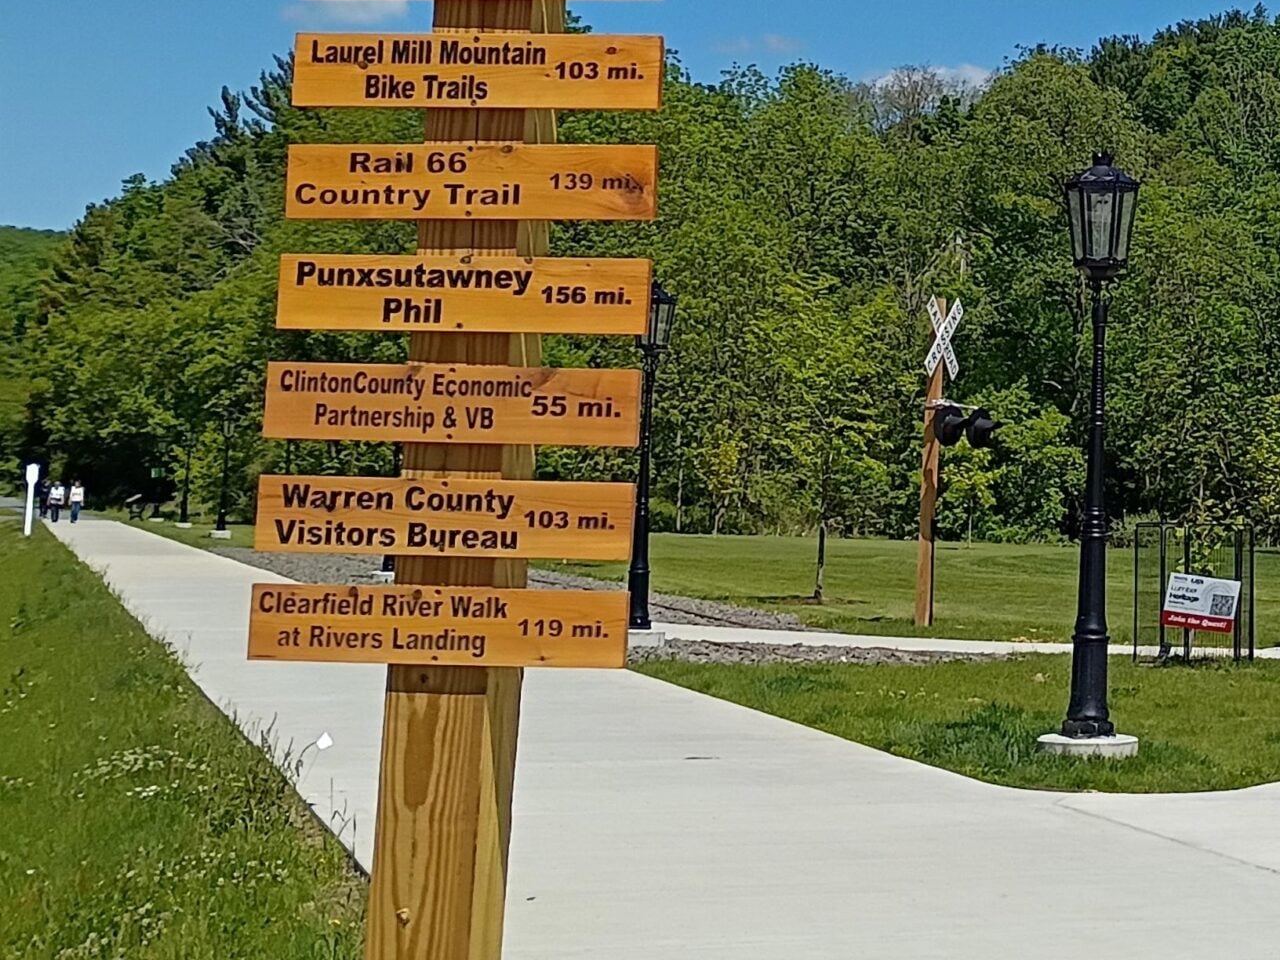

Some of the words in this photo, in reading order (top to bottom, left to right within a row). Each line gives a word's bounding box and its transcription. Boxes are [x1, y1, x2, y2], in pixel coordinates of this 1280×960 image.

[311, 40, 384, 64] Laurel
[392, 41, 431, 64] Mill
[439, 41, 546, 65] Mountain
[554, 62, 599, 80] 103
[607, 62, 644, 80] mi.
[364, 75, 415, 99] Bike
[423, 75, 488, 100] Trails
[349, 152, 413, 173] Rail
[427, 152, 467, 173] 66
[549, 173, 593, 190] 139
[602, 173, 639, 190] mi.
[295, 183, 431, 211] Country
[444, 184, 521, 205] Trail
[296, 261, 533, 295] Punxsutawney
[541, 286, 586, 304] 156
[594, 287, 632, 305] mi.
[382, 298, 442, 323] Phil
[432, 373, 532, 398] Economic
[314, 403, 435, 433] Partnership
[442, 407, 457, 429] &
[465, 407, 494, 430] VB
[531, 396, 567, 417] 55
[578, 396, 621, 418] mi.
[282, 483, 394, 511] Warren
[405, 486, 515, 519] County
[524, 511, 568, 529] 103
[578, 511, 615, 530] mi.
[274, 519, 396, 547] Visitors
[407, 522, 518, 550] Bureau
[259, 591, 373, 616] Clearfield
[382, 594, 441, 618] River
[450, 596, 508, 619] Walk
[1169, 592, 1199, 602] Heritage
[518, 619, 563, 637] 119
[572, 620, 609, 638] mi.
[1202, 619, 1227, 628] Quest!
[277, 627, 301, 647] at
[309, 625, 383, 649] Rivers
[392, 628, 486, 657] Landing
